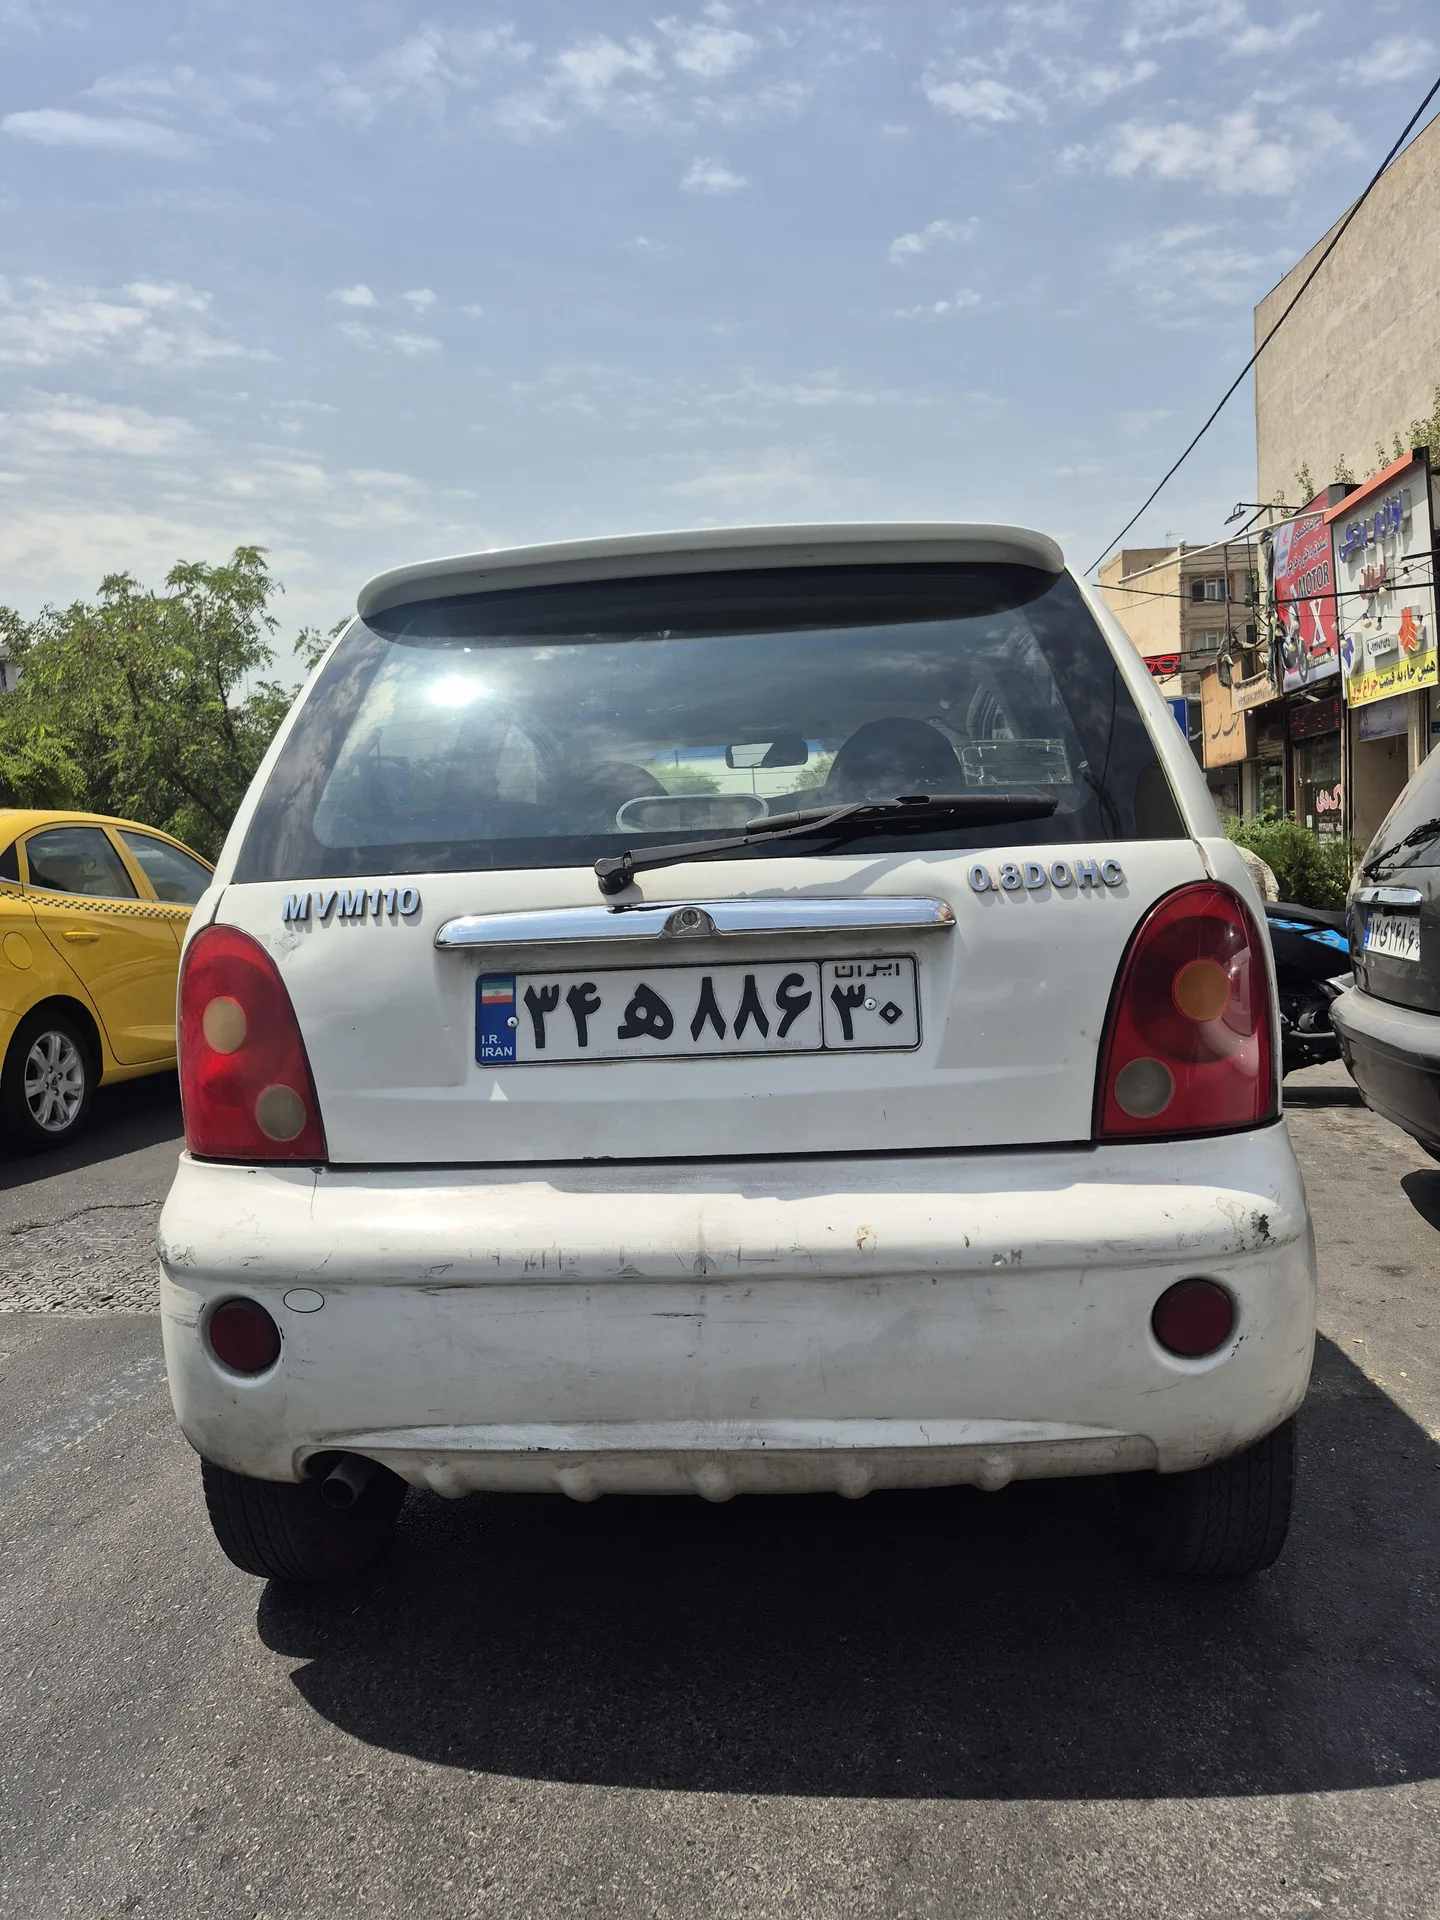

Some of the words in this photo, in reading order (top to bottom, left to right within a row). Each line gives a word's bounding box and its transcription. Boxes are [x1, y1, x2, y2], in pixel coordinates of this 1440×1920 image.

[1297, 560, 1331, 598] MOTOR
[967, 858, 1123, 893] 0.8DOHC
[281, 886, 421, 922] MVM110
[834, 963, 900, 978] ایران
[830, 984, 904, 1040] ۳۰
[481, 1034, 502, 1046] I.R.
[481, 1046, 513, 1058] IRAN
